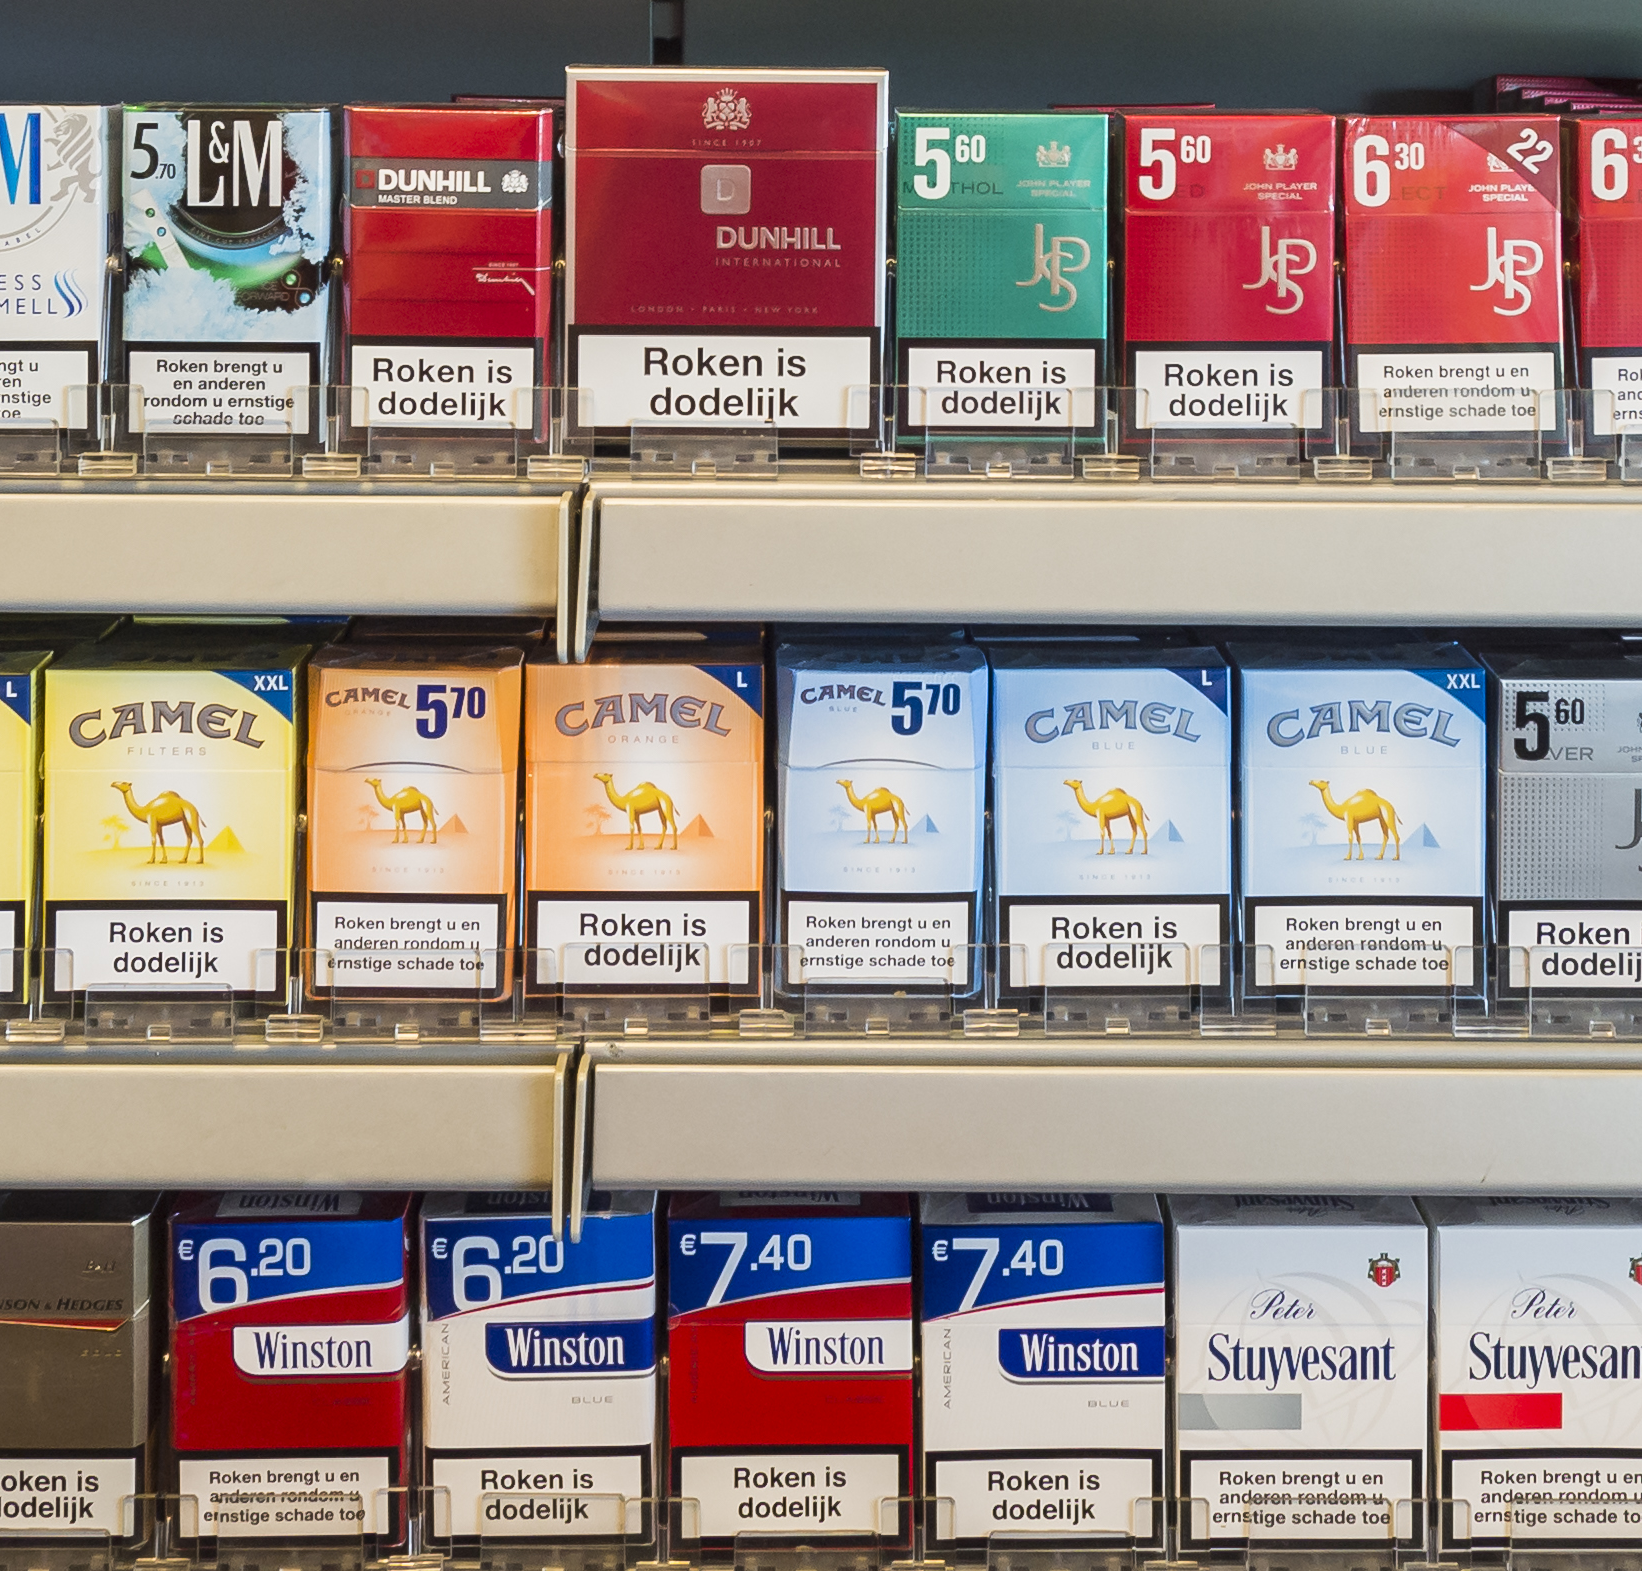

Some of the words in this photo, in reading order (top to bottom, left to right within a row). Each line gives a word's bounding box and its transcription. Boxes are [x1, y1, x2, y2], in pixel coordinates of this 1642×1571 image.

[378, 170, 490, 193] DUNHILL
[1244, 182, 1273, 191] JOHN
[1276, 182, 1317, 191] PLAYER
[378, 194, 420, 204] MASTER
[423, 195, 458, 205] BLEND
[1257, 192, 1303, 201] SPECIAL
[716, 227, 840, 249] DUNHILL
[715, 257, 841, 267] INTERNATIONAL
[1165, 364, 1257, 385] Roken
[1270, 364, 1293, 386] is
[1169, 394, 1288, 421] dodelijk
[6, 681, 17, 697] L
[254, 675, 288, 691] XXL
[557, 693, 730, 737] CAMEL
[1025, 701, 1200, 743] CAMEL
[608, 736, 679, 744] ORANGE
[1092, 742, 1134, 750] BLUE
[57, 1297, 123, 1312] HEDGES
[1250, 1288, 1318, 1322] Peter
[253, 1331, 371, 1370] Winston
[506, 1328, 624, 1368] Winston
[441, 1324, 451, 1406] AMERICAN
[1207, 1332, 1396, 1389] Stuyvesant
